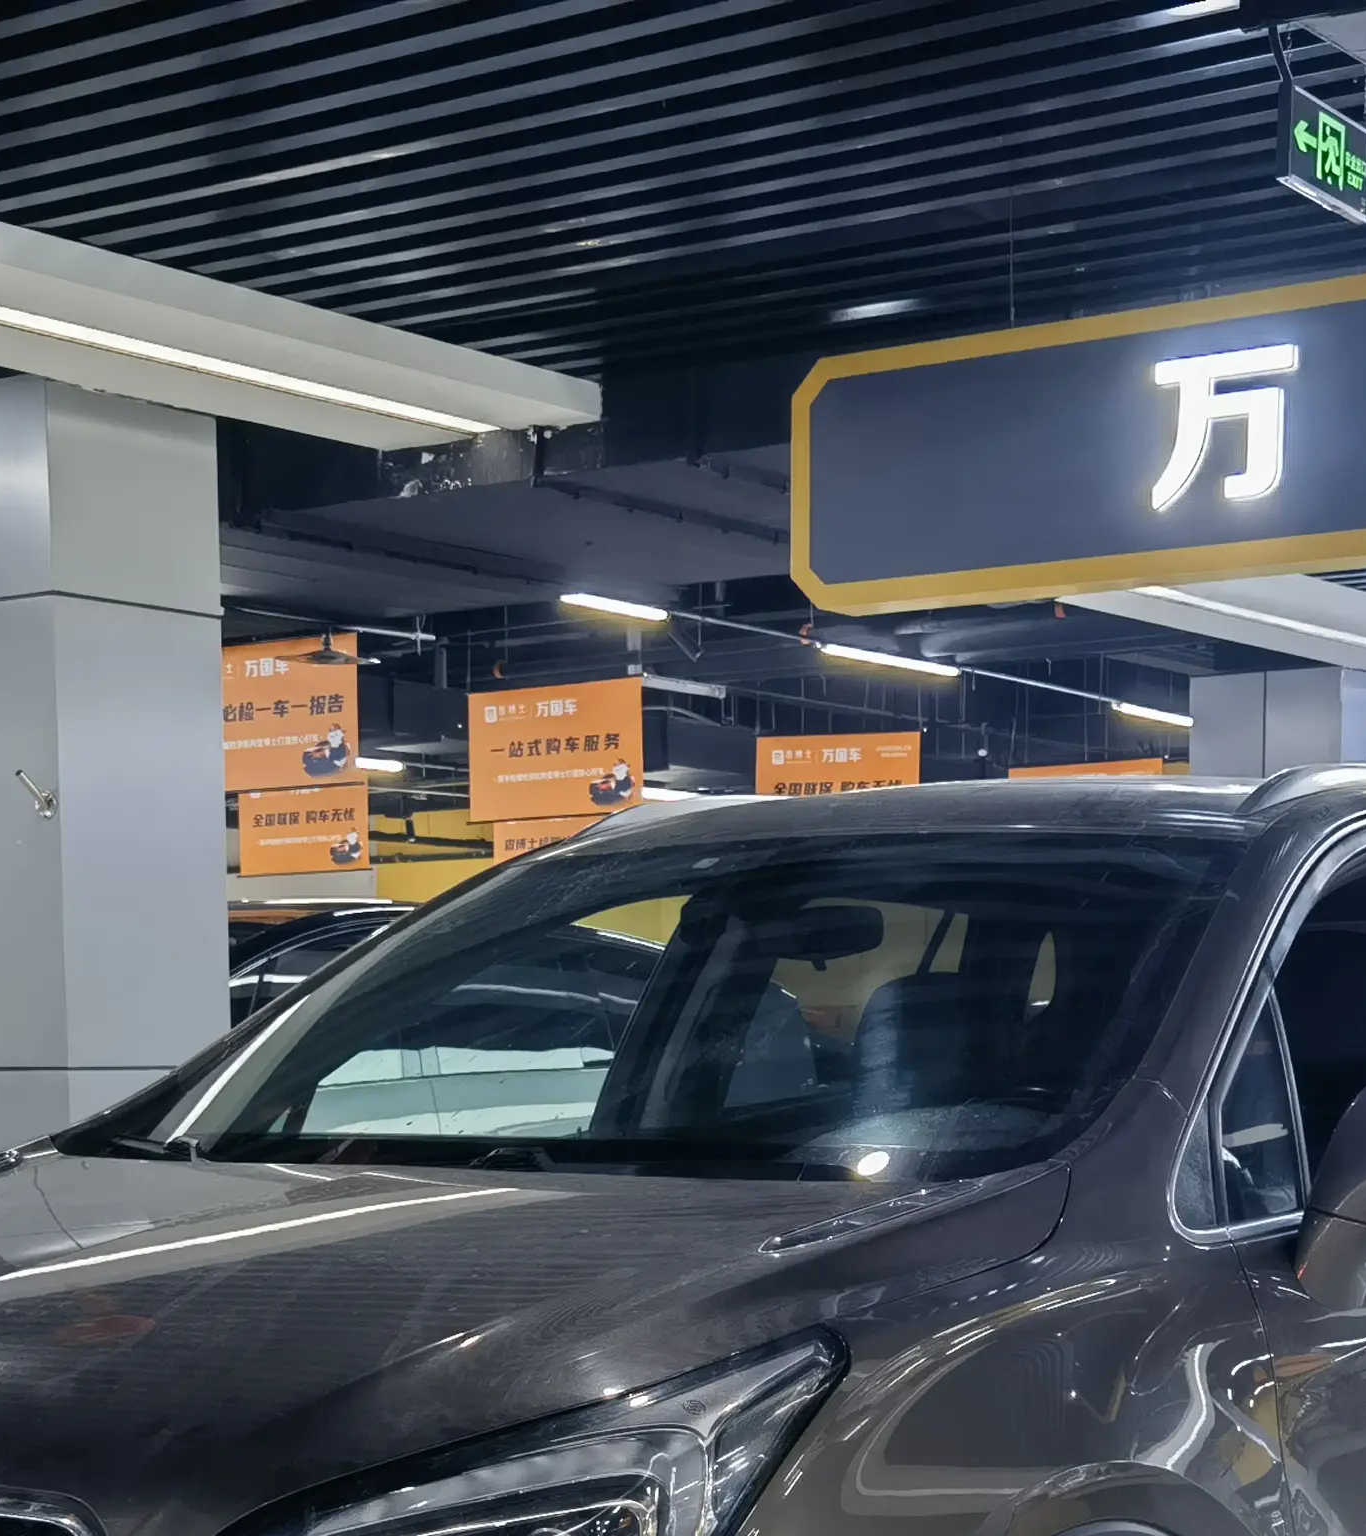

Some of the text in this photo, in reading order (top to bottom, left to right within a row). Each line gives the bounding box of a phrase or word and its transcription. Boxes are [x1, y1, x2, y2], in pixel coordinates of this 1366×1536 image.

[1347, 171, 1363, 191] EXIT
[245, 658, 290, 678] 万国车
[536, 699, 577, 718] 万国车
[490, 733, 620, 758] 一站式购车服务
[822, 748, 862, 763] 万国车
[774, 782, 834, 796] 全国联保
[253, 807, 355, 828] 全国联保 购车无忧
